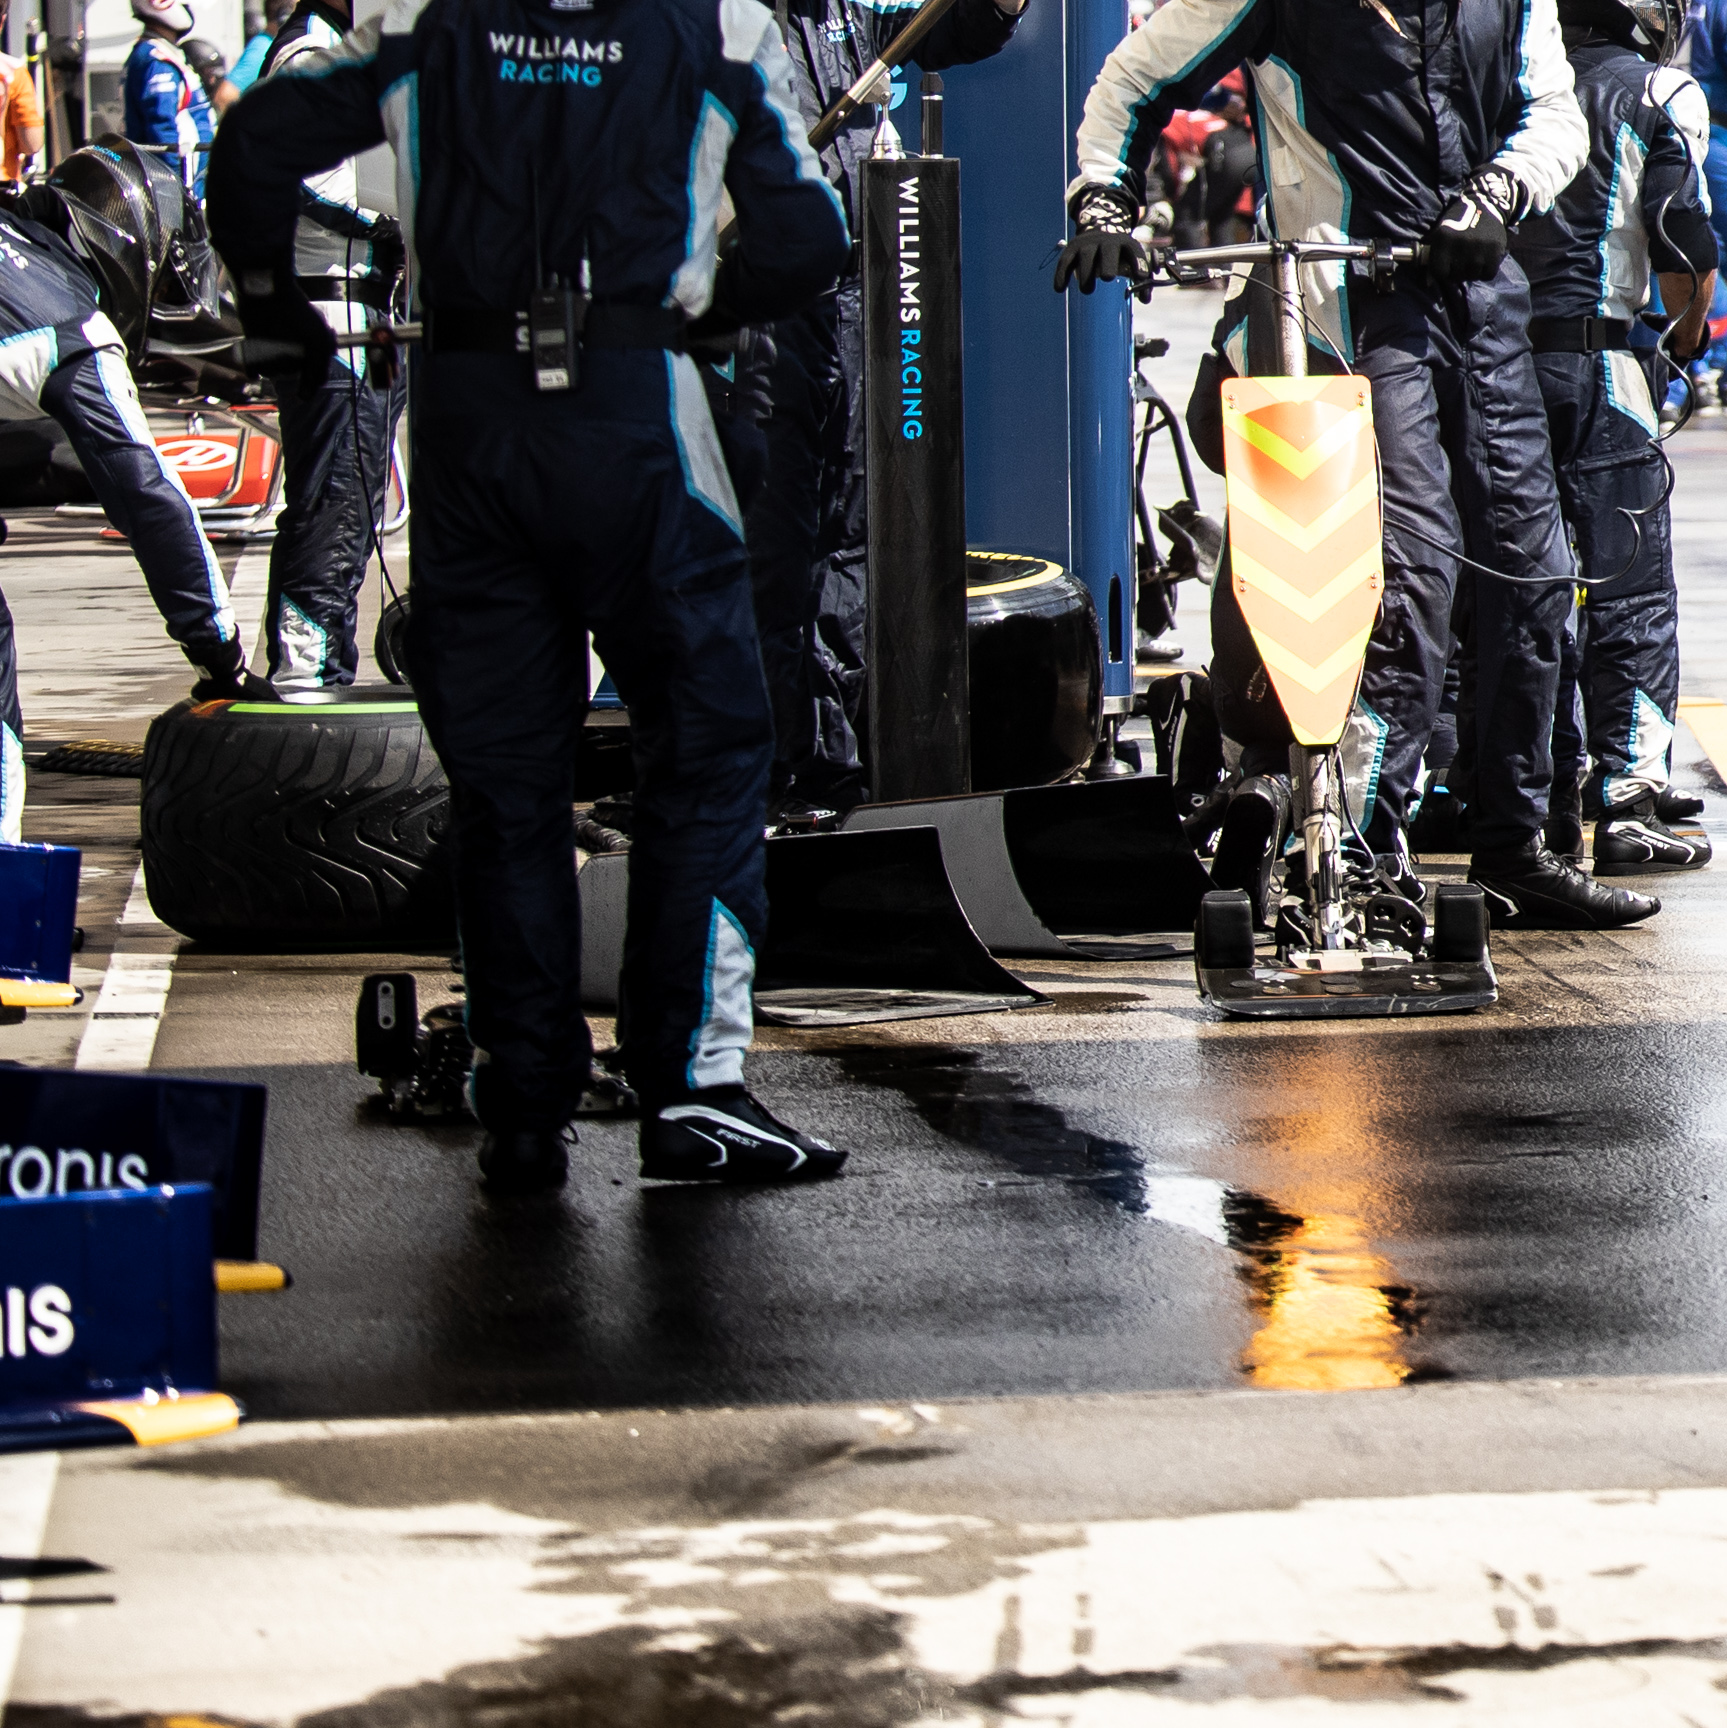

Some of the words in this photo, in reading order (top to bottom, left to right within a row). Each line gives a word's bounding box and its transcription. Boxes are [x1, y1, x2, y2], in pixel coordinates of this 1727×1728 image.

[489, 30, 623, 63] WILLIAMS
[500, 59, 602, 87] RACING
[899, 176, 921, 322] WILLIAMS
[901, 329, 923, 440] RACING
